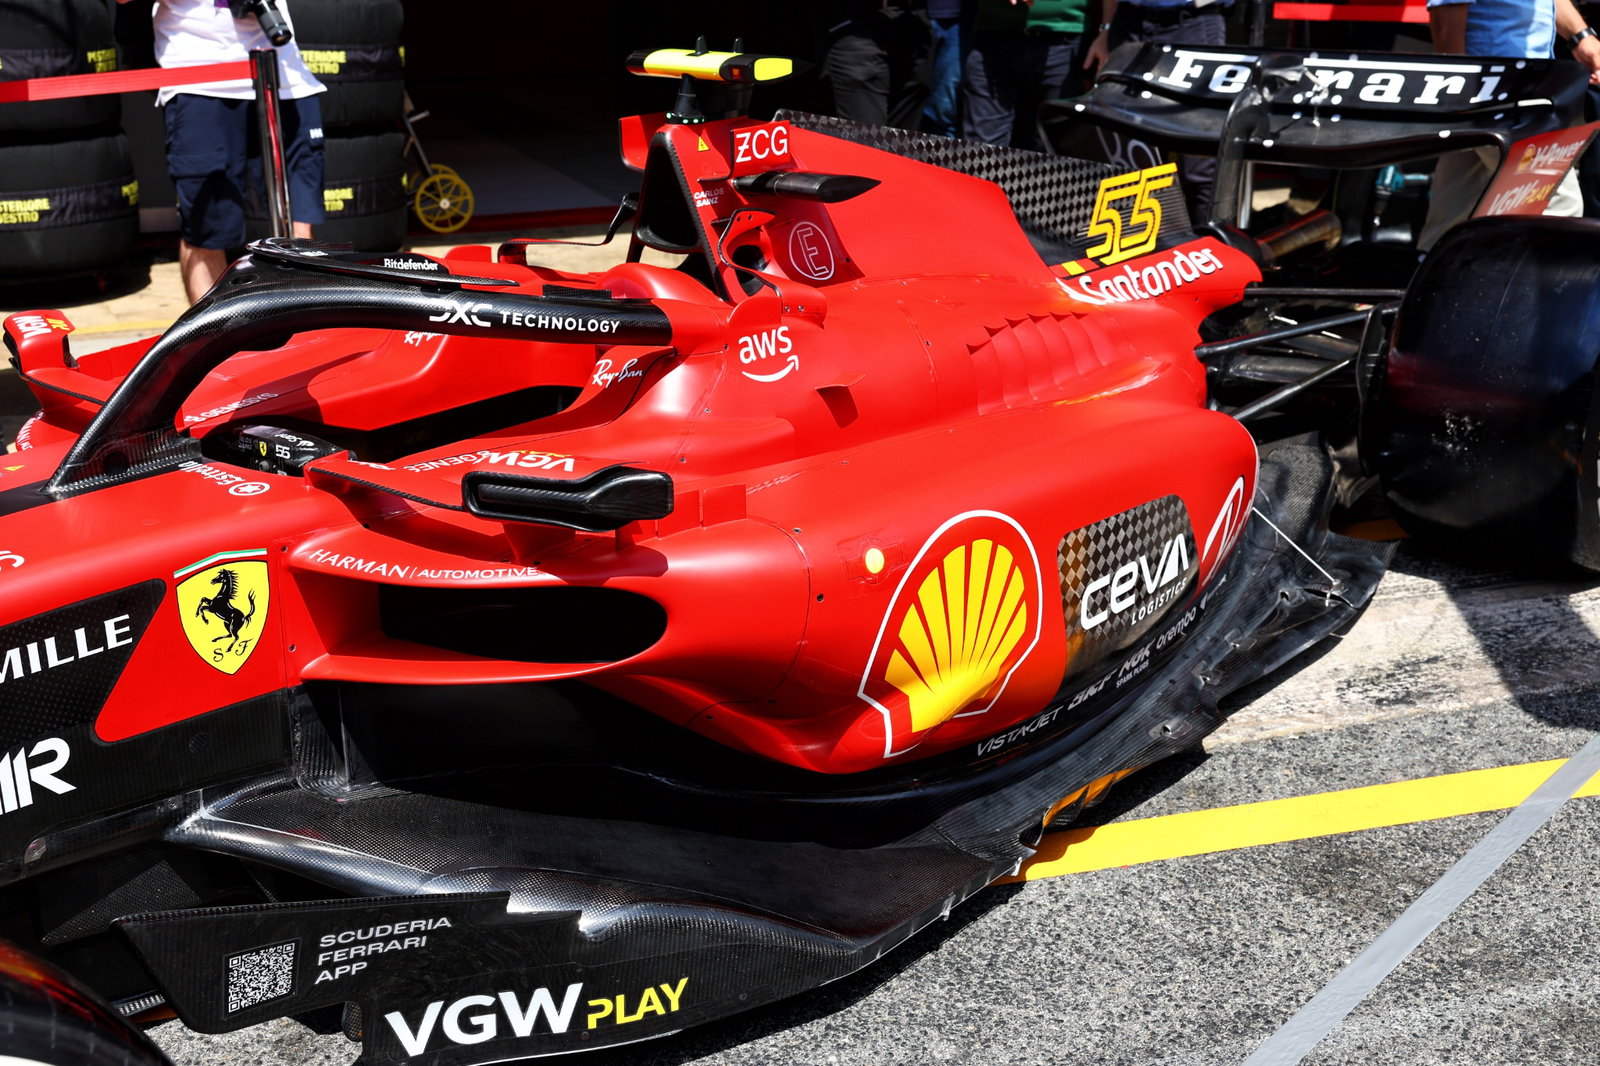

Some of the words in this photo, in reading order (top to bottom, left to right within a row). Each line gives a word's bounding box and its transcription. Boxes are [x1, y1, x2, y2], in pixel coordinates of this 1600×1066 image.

[1158, 50, 1506, 105] Ferari
[735, 126, 788, 163] ZCG
[693, 187, 724, 199] CARLOS
[696, 197, 719, 207] SAINZ
[1086, 163, 1178, 265] 55
[383, 258, 438, 271] Bitdefender
[1078, 248, 1223, 304] Santander
[500, 311, 620, 334] TECHNOLOGY
[738, 326, 793, 364] aws
[275, 444, 291, 459] 55
[416, 566, 540, 579] AUTOMOTIVE
[1131, 577, 1188, 625] LOGISTICS
[0, 614, 133, 684] MILLE
[319, 916, 453, 948] SCUDERIA
[317, 936, 428, 966] FERRARI
[315, 961, 368, 985] APP
[384, 982, 584, 1057] VGW
[587, 977, 689, 1030] PLAY
